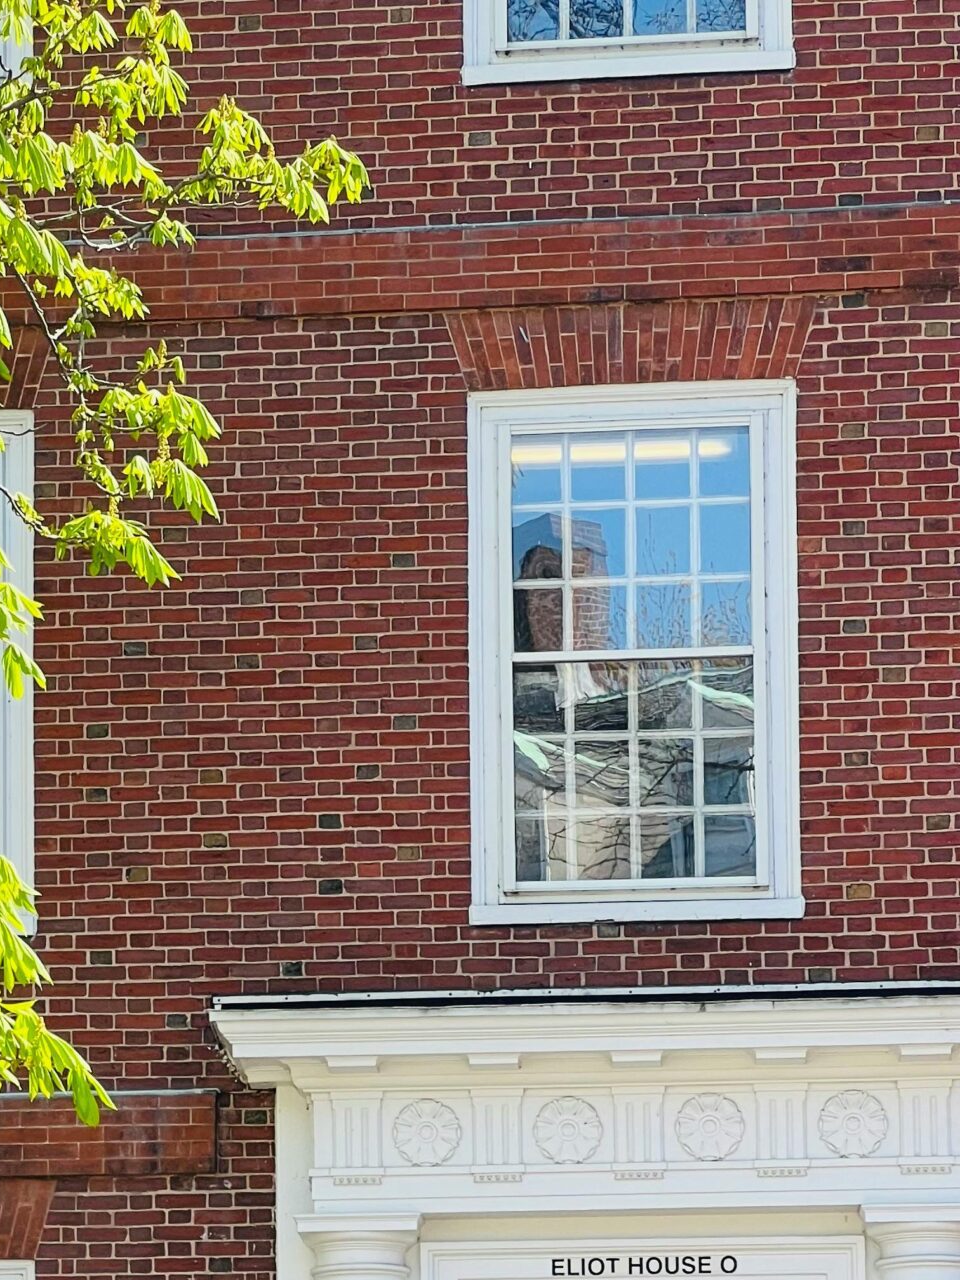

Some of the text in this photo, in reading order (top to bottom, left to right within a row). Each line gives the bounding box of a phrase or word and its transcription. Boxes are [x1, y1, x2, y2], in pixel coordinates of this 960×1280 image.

[551, 1255, 738, 1276] ELIOT HOUSE O
